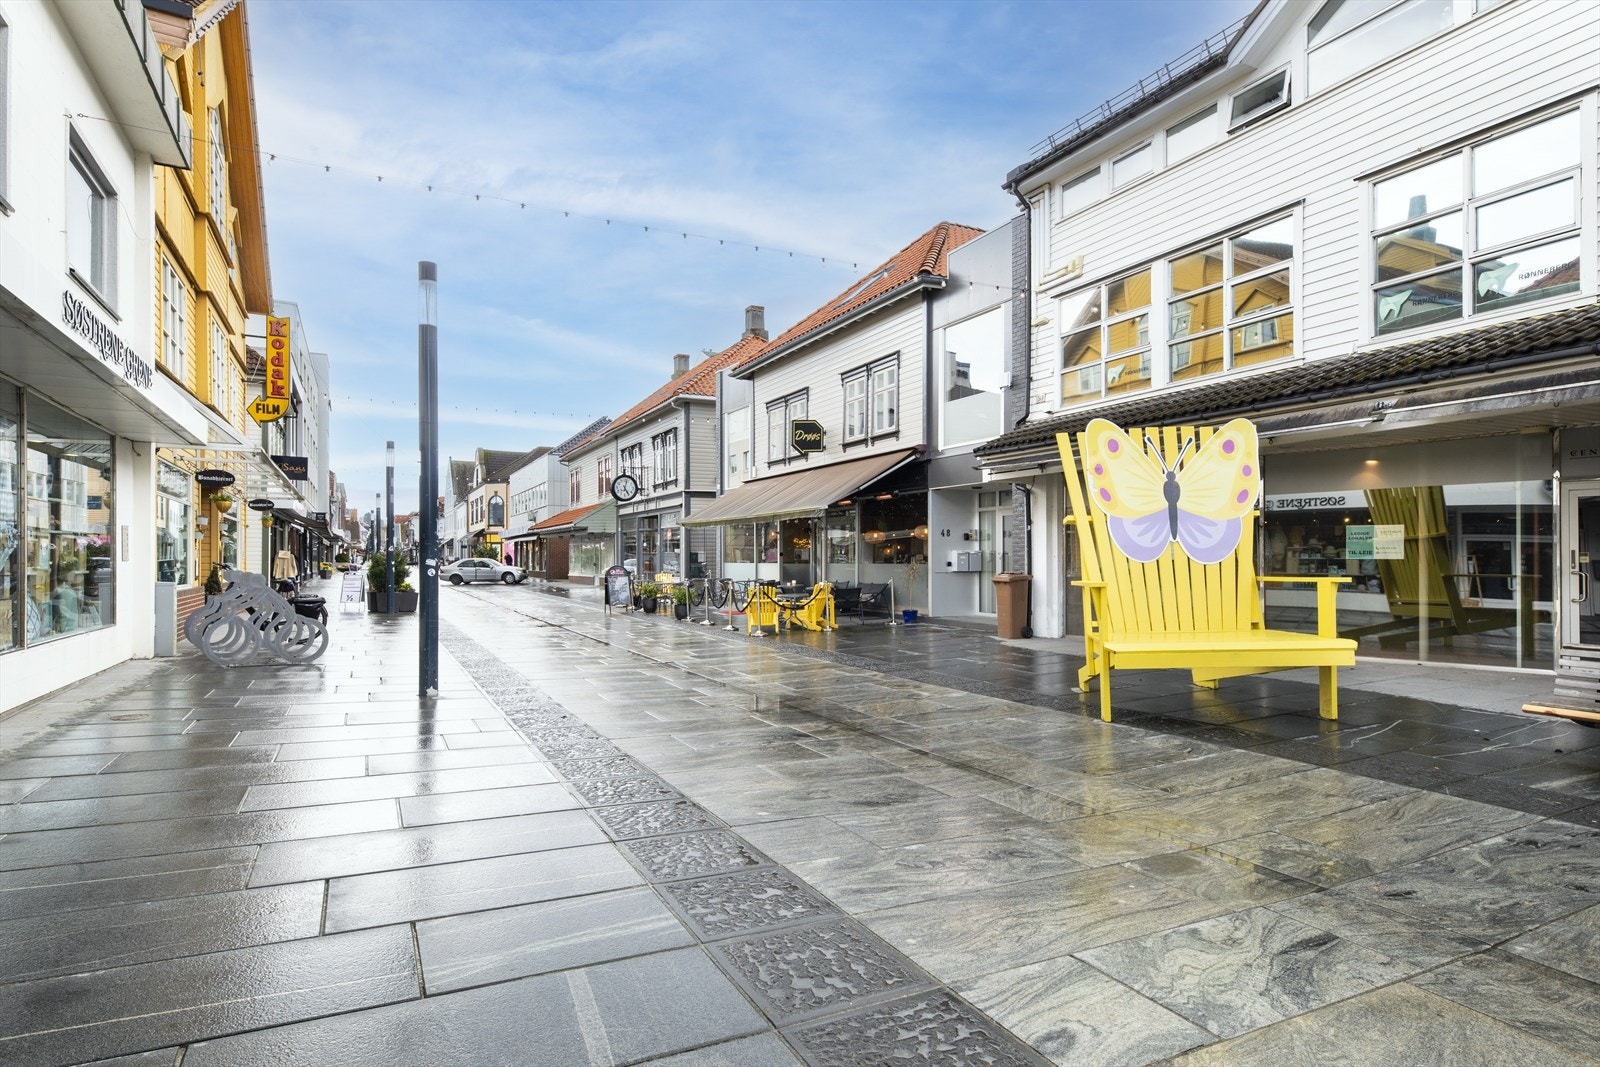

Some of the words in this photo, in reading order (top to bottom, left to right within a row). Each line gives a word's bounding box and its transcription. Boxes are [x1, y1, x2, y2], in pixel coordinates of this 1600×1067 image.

[62, 290, 124, 366] SØSTRENE
[124, 347, 153, 390] GRENE
[268, 320, 287, 396] Kodak
[255, 403, 280, 415] FILM
[795, 430, 821, 442] Drøøs
[940, 528, 951, 538] 48
